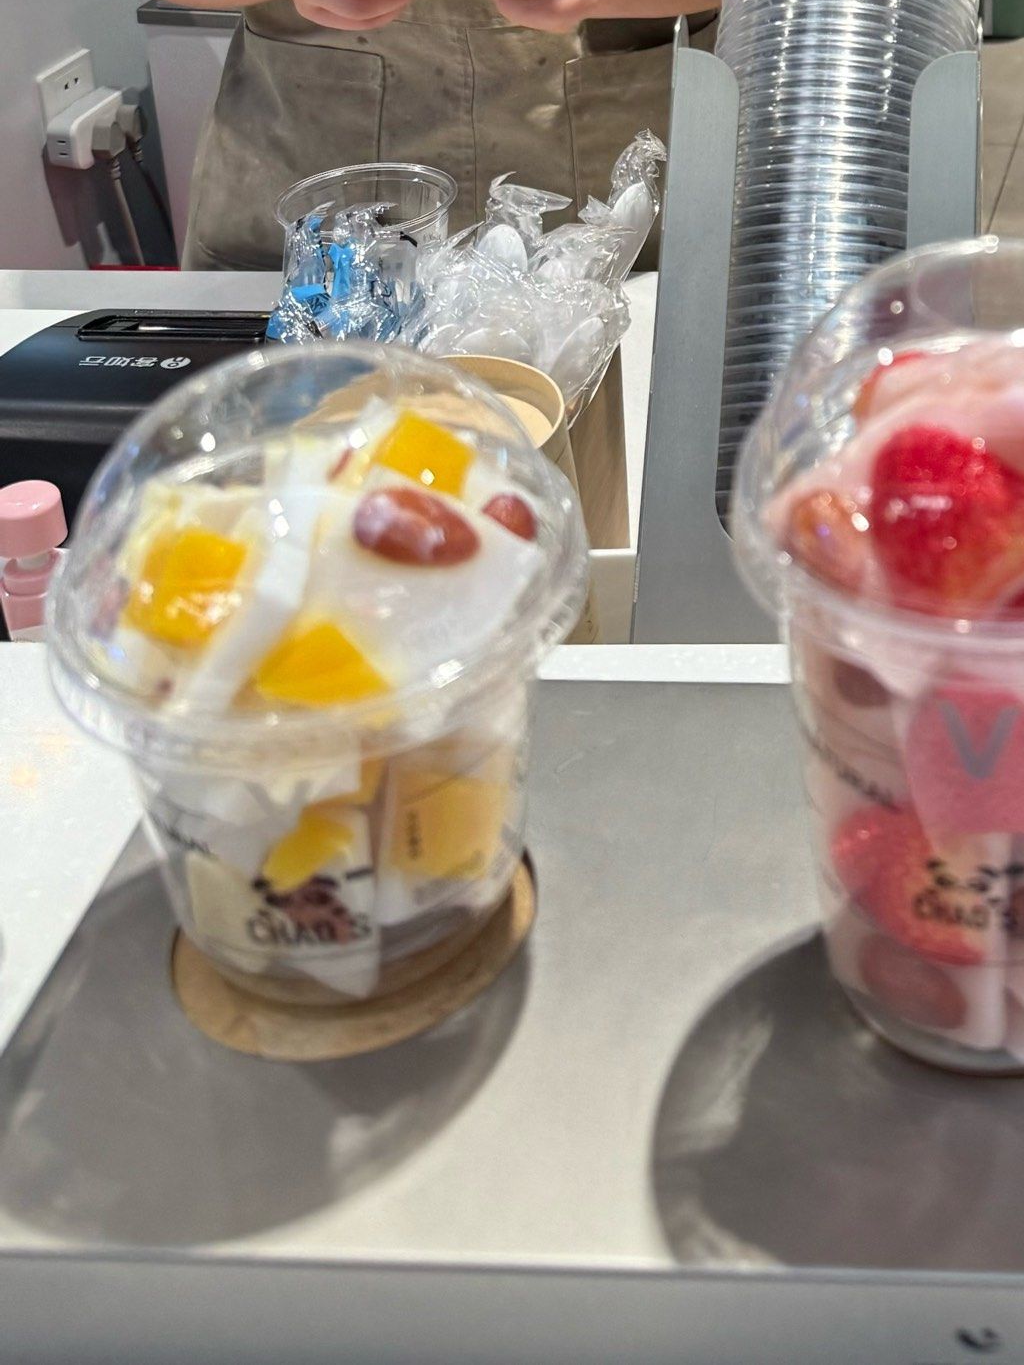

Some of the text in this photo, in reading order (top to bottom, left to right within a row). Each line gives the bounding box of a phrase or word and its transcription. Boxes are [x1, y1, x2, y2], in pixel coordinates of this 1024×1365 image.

[78, 354, 159, 369] 客如云
[938, 700, 1022, 780] V
